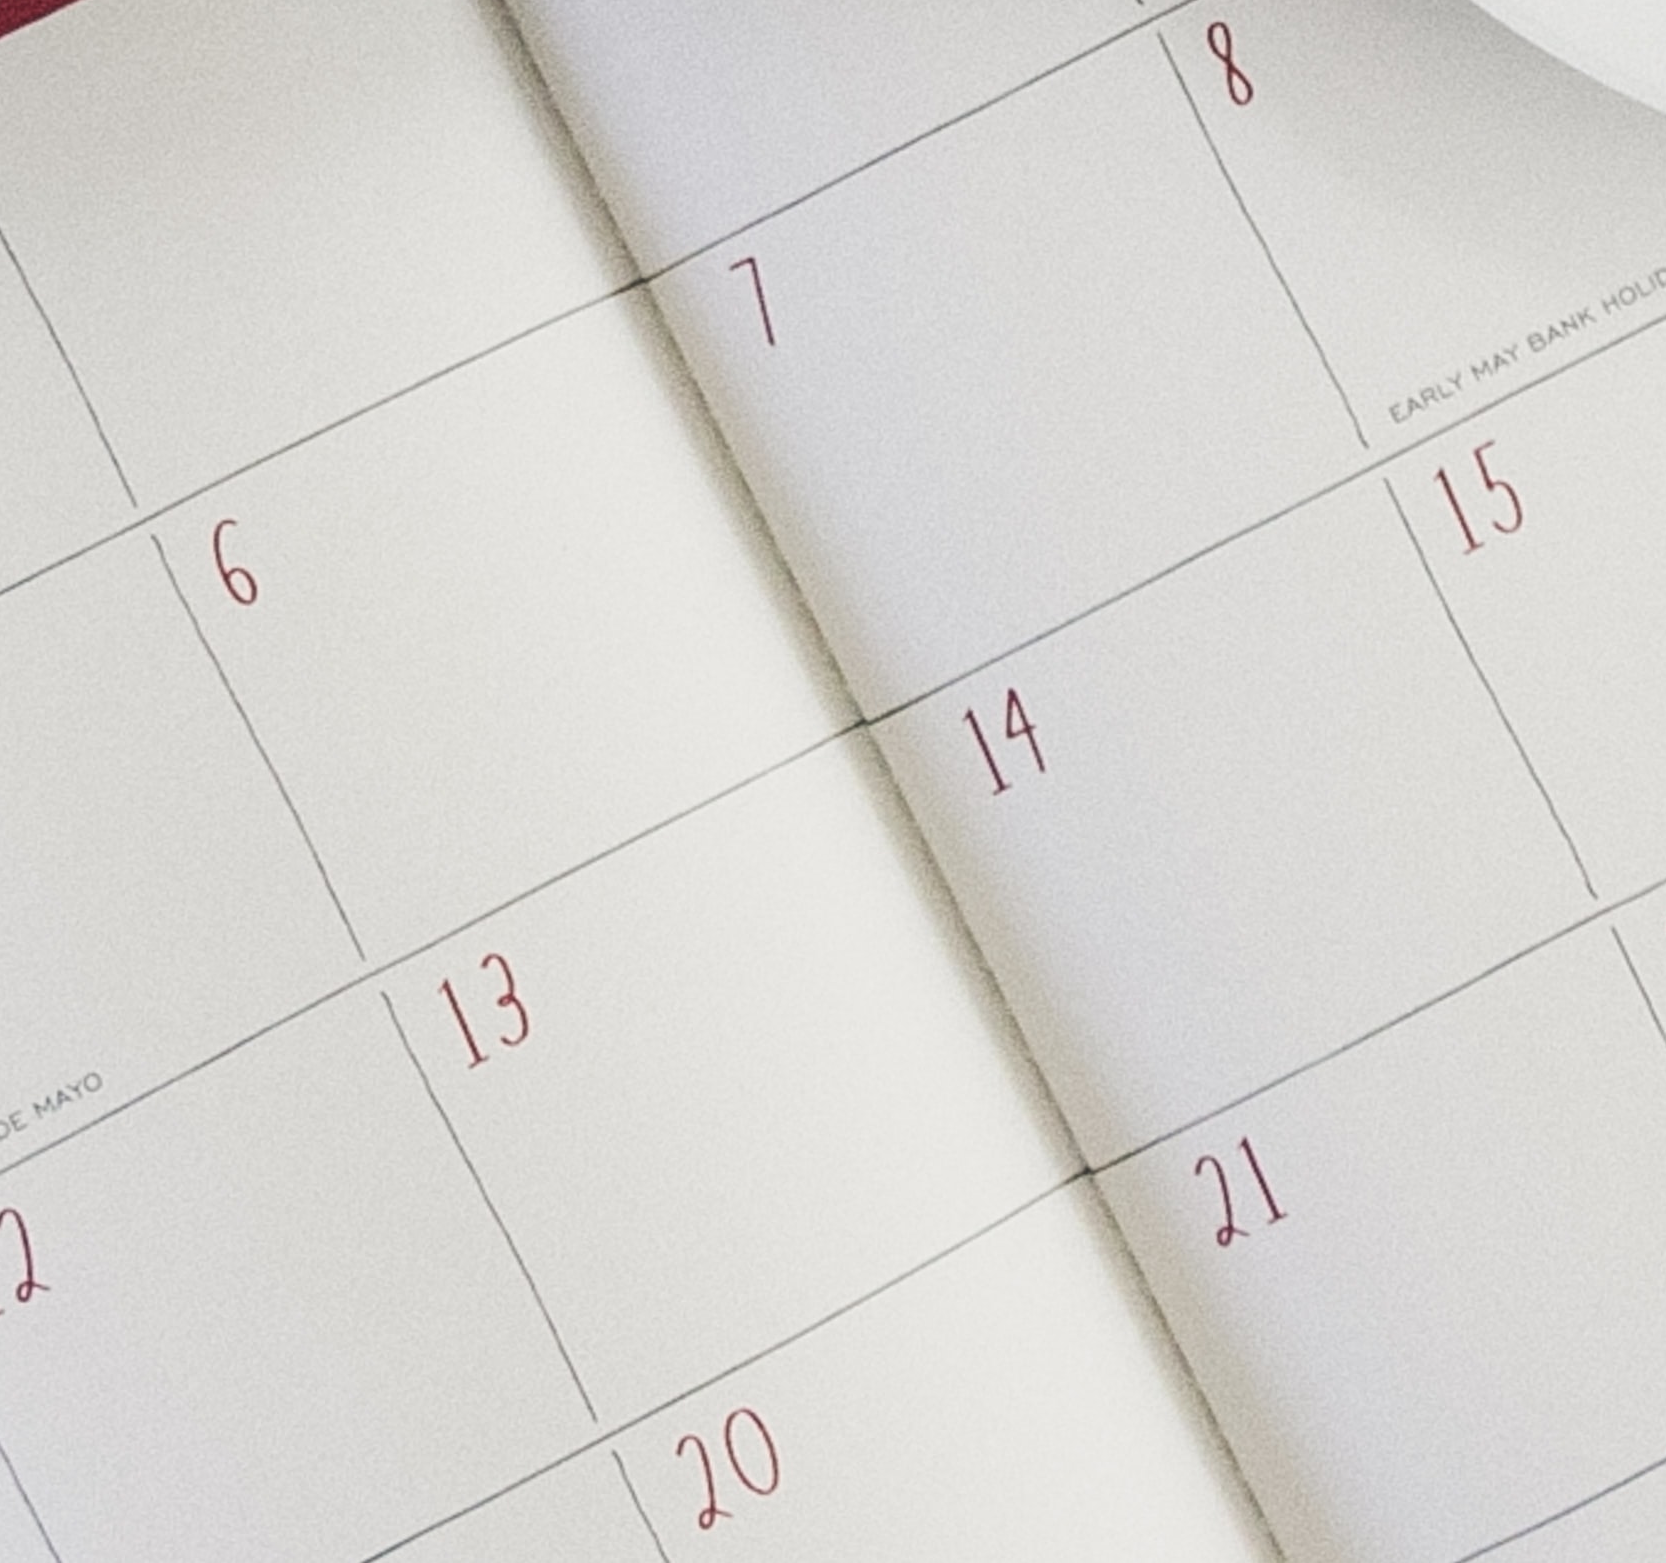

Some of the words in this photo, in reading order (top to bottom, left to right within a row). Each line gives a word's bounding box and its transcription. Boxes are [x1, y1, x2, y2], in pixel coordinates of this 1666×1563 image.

[1206, 21, 1255, 107] 8
[729, 256, 776, 347] 7
[1388, 371, 1464, 424] EARLY
[1470, 344, 1520, 382] MAY
[1527, 307, 1597, 353] BANK
[1434, 440, 1524, 555] 15
[212, 518, 259, 606] 6
[962, 687, 1046, 796] 14
[438, 952, 530, 1069] 13
[33, 1072, 103, 1119] MAYO
[1194, 1136, 1288, 1248] 21
[675, 1407, 780, 1531] 20
